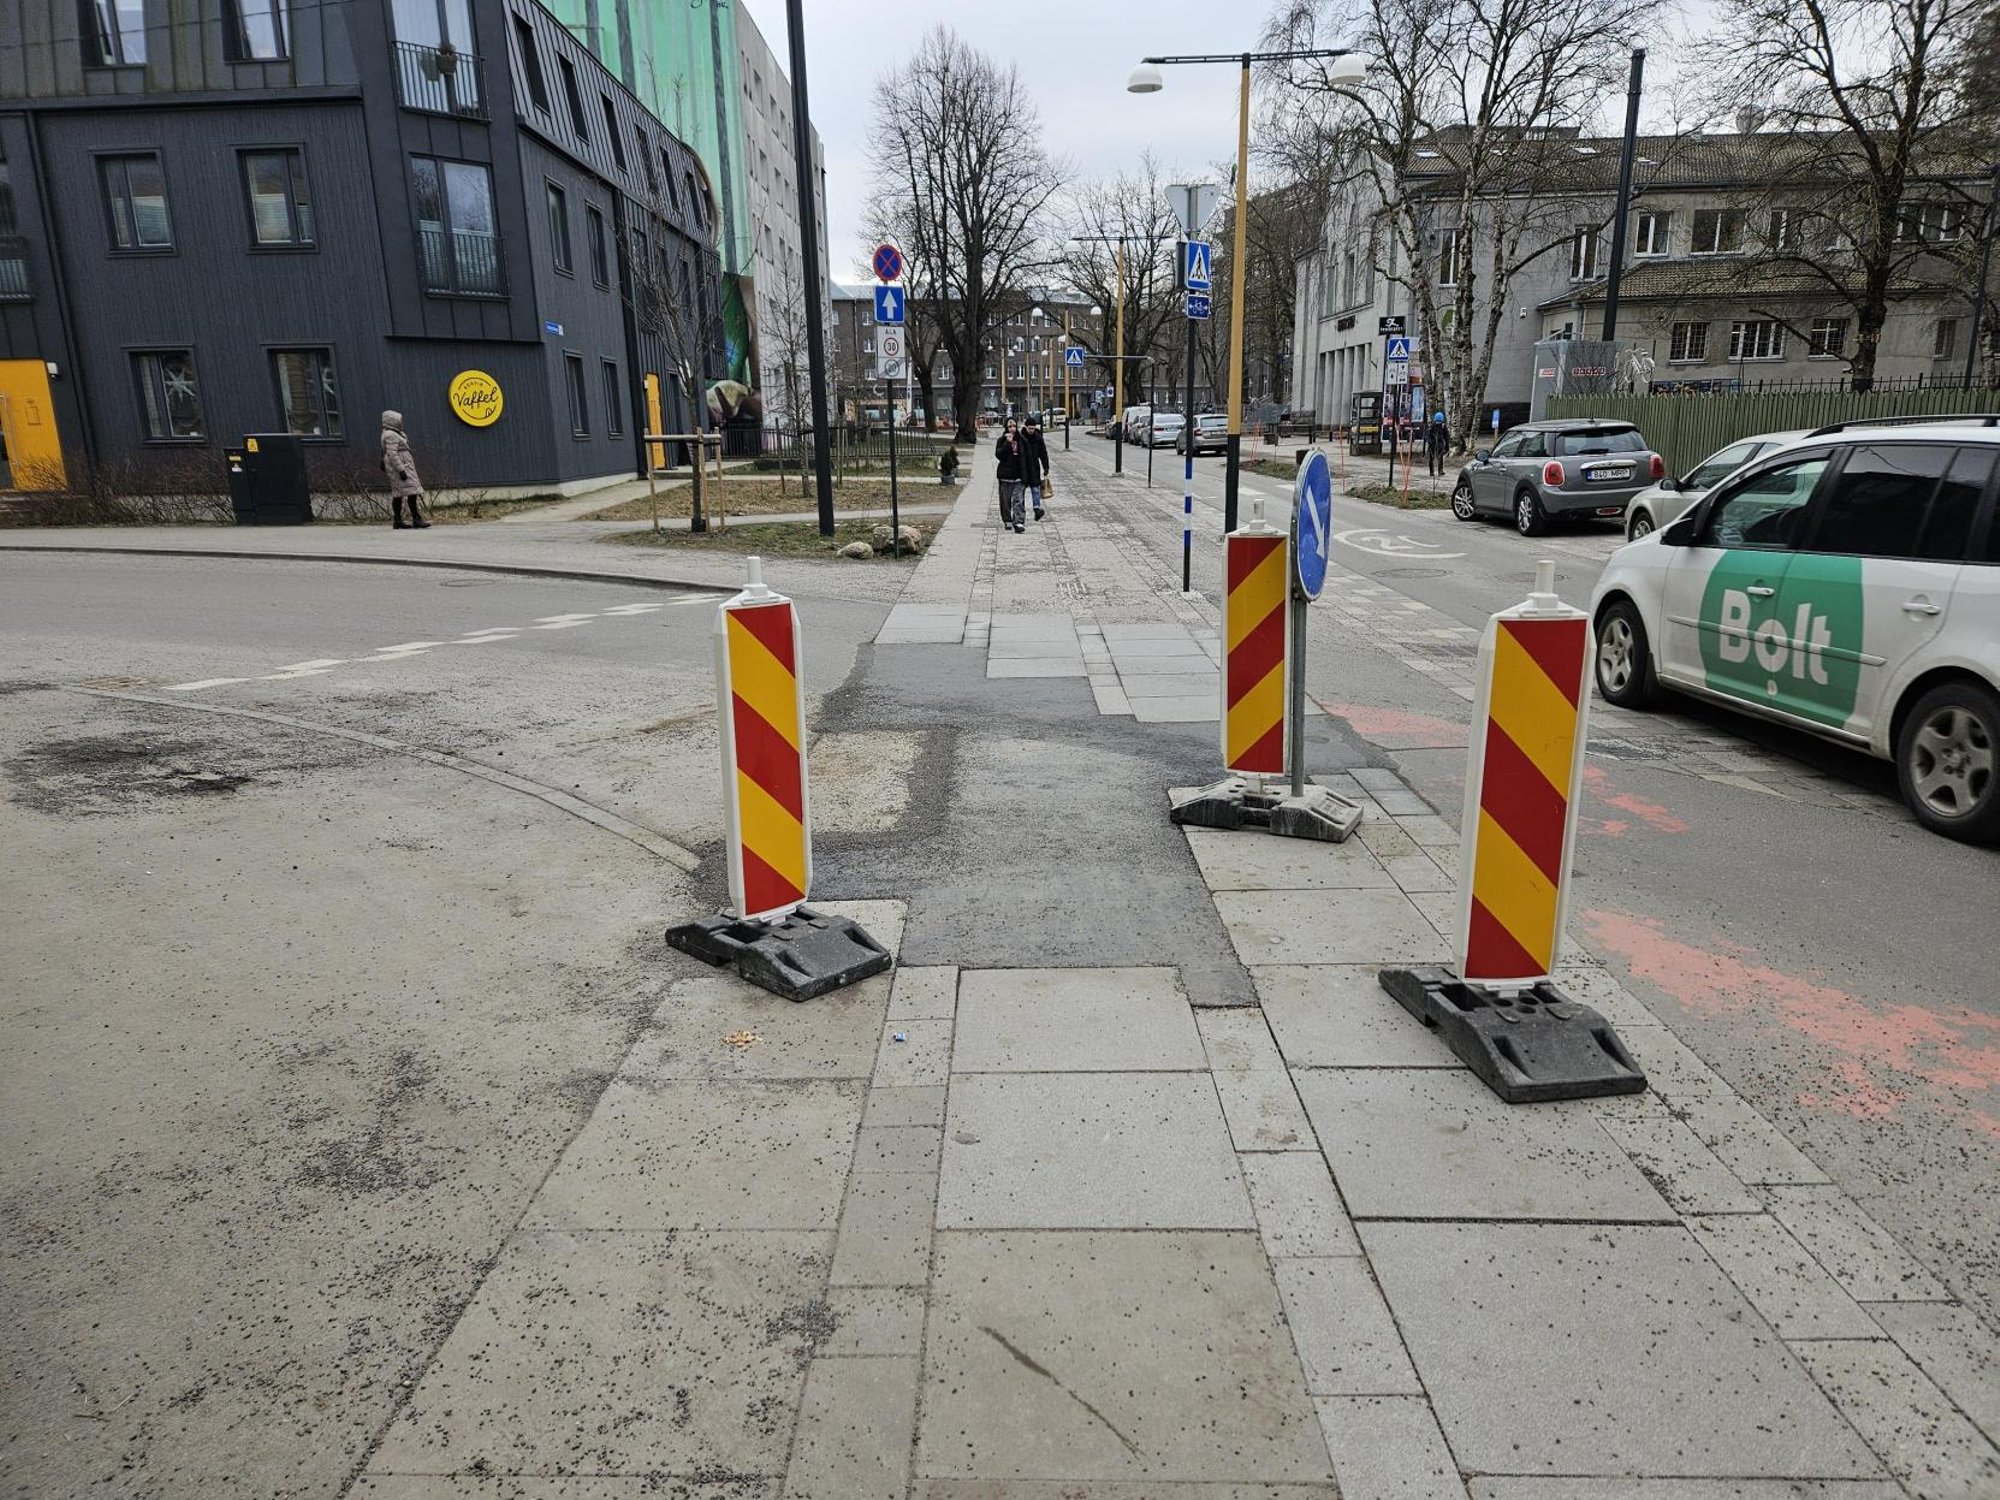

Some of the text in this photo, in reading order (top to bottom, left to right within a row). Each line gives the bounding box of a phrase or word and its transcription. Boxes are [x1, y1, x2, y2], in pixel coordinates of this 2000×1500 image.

[887, 342, 896, 351] 30
[453, 387, 498, 409] Vaffel
[1594, 470, 1607, 479] 840
[1720, 588, 1832, 686] Bolt
